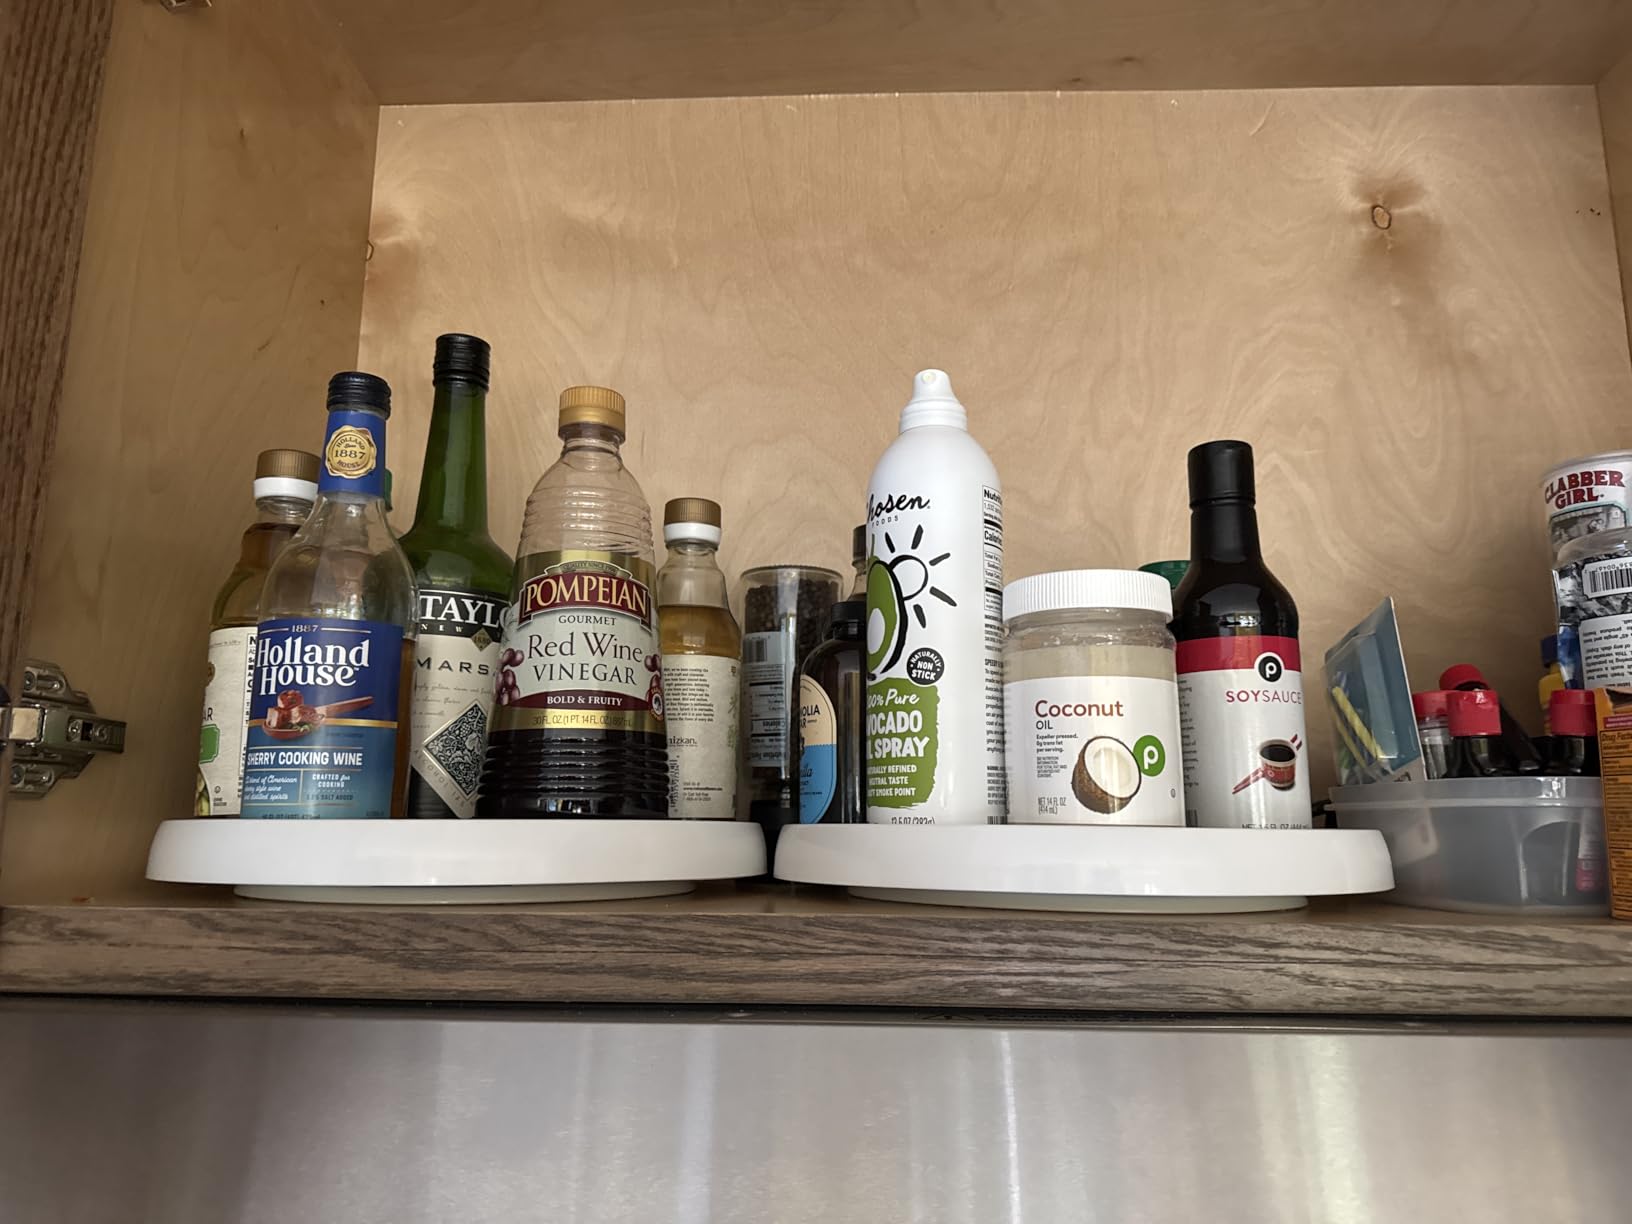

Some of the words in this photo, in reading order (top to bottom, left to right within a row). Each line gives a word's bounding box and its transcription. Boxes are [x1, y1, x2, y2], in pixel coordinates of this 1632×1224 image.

[336, 437, 366, 450] HOLLAND
[334, 450, 366, 460] 1887
[337, 460, 361, 468] HOUSE
[1544, 470, 1625, 504] CLABBER
[1555, 487, 1598, 510] GIRL
[526, 575, 647, 616] POMPEIAN
[420, 595, 500, 628] TAYL
[558, 615, 616, 626] GOURMET
[292, 624, 318, 632] 1887
[256, 636, 370, 667] Holland
[528, 632, 576, 660] Red
[583, 632, 642, 662] Wine
[418, 656, 490, 675] MARS
[910, 650, 942, 668] NATURALLY
[917, 661, 934, 670] NON
[259, 665, 356, 695] House
[533, 663, 638, 686] VINEGAR
[912, 669, 936, 680] STICK
[546, 696, 574, 704] BOLD
[577, 696, 586, 704] &
[588, 696, 622, 706] FRUITY
[884, 688, 920, 706] Pure
[1035, 700, 1124, 718] Coconut
[582, 716, 589, 724] 14
[1036, 720, 1054, 730] OIL
[874, 736, 930, 759] SPRAY
[247, 752, 276, 766] SHERRY
[278, 752, 330, 766] COOKING
[333, 752, 363, 766] WINE
[888, 764, 918, 774] REFINED
[268, 774, 297, 784] American
[888, 776, 908, 784] TASTE
[876, 788, 893, 797] SMOKE
[894, 787, 916, 796] POINT
